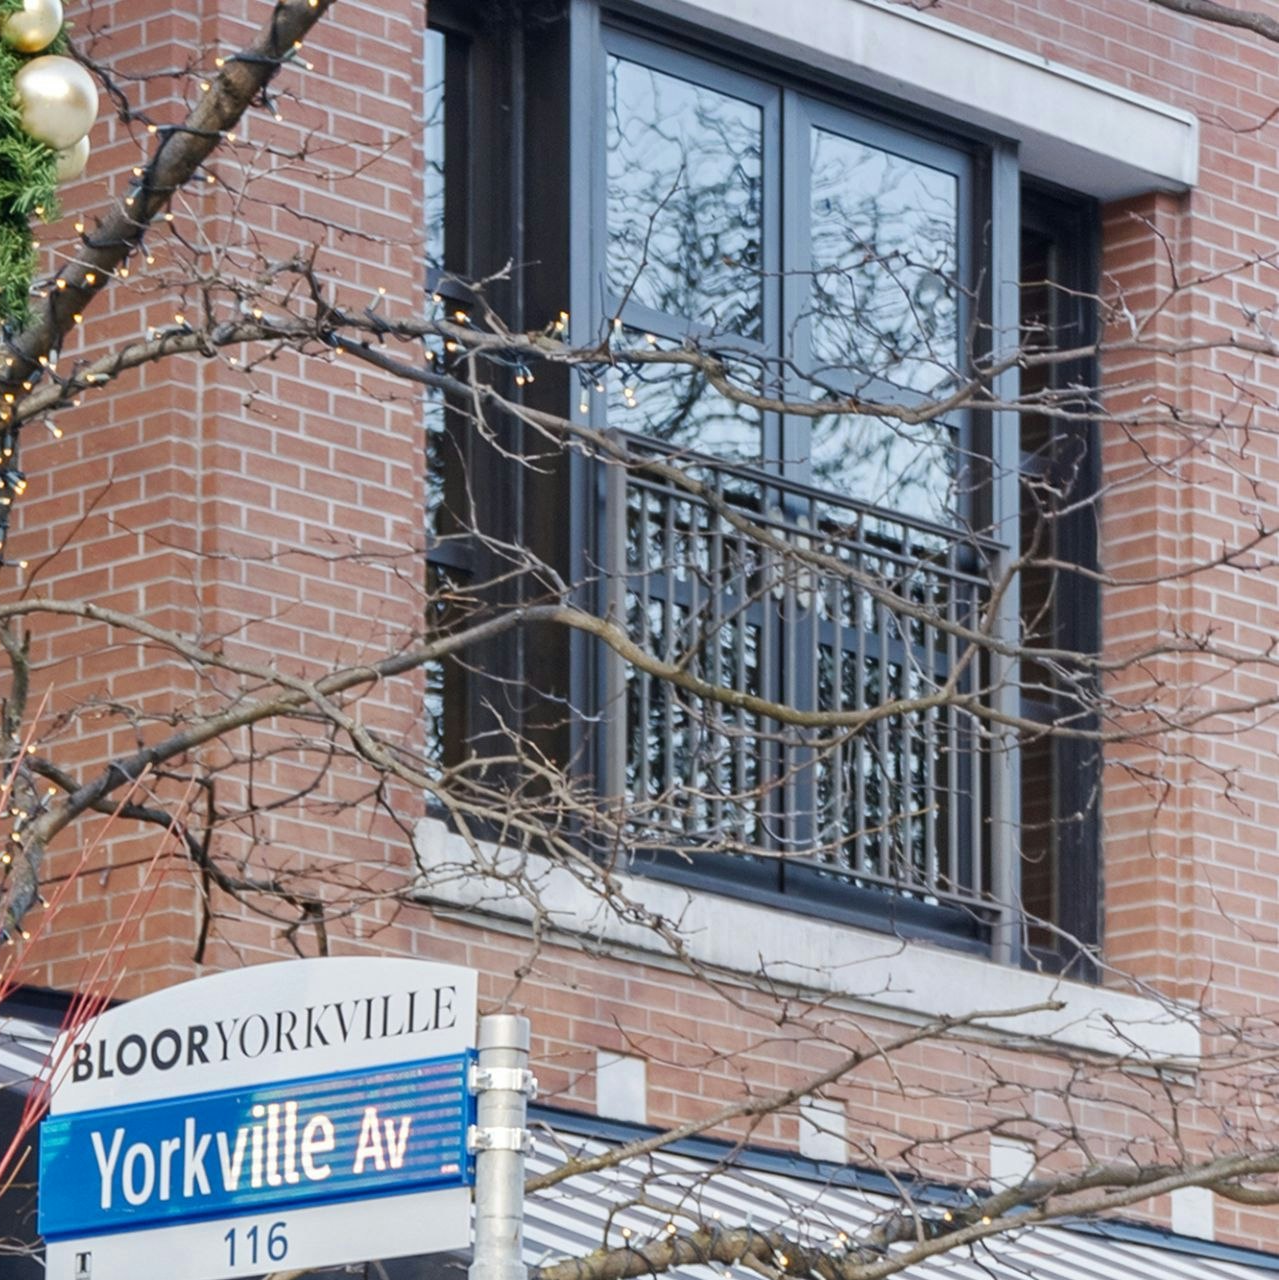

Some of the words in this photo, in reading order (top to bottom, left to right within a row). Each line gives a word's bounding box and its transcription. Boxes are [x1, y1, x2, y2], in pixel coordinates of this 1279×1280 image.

[90, 1101, 335, 1210] Yorkville
[353, 1108, 412, 1175] Av
[224, 1222, 289, 1267] 116
